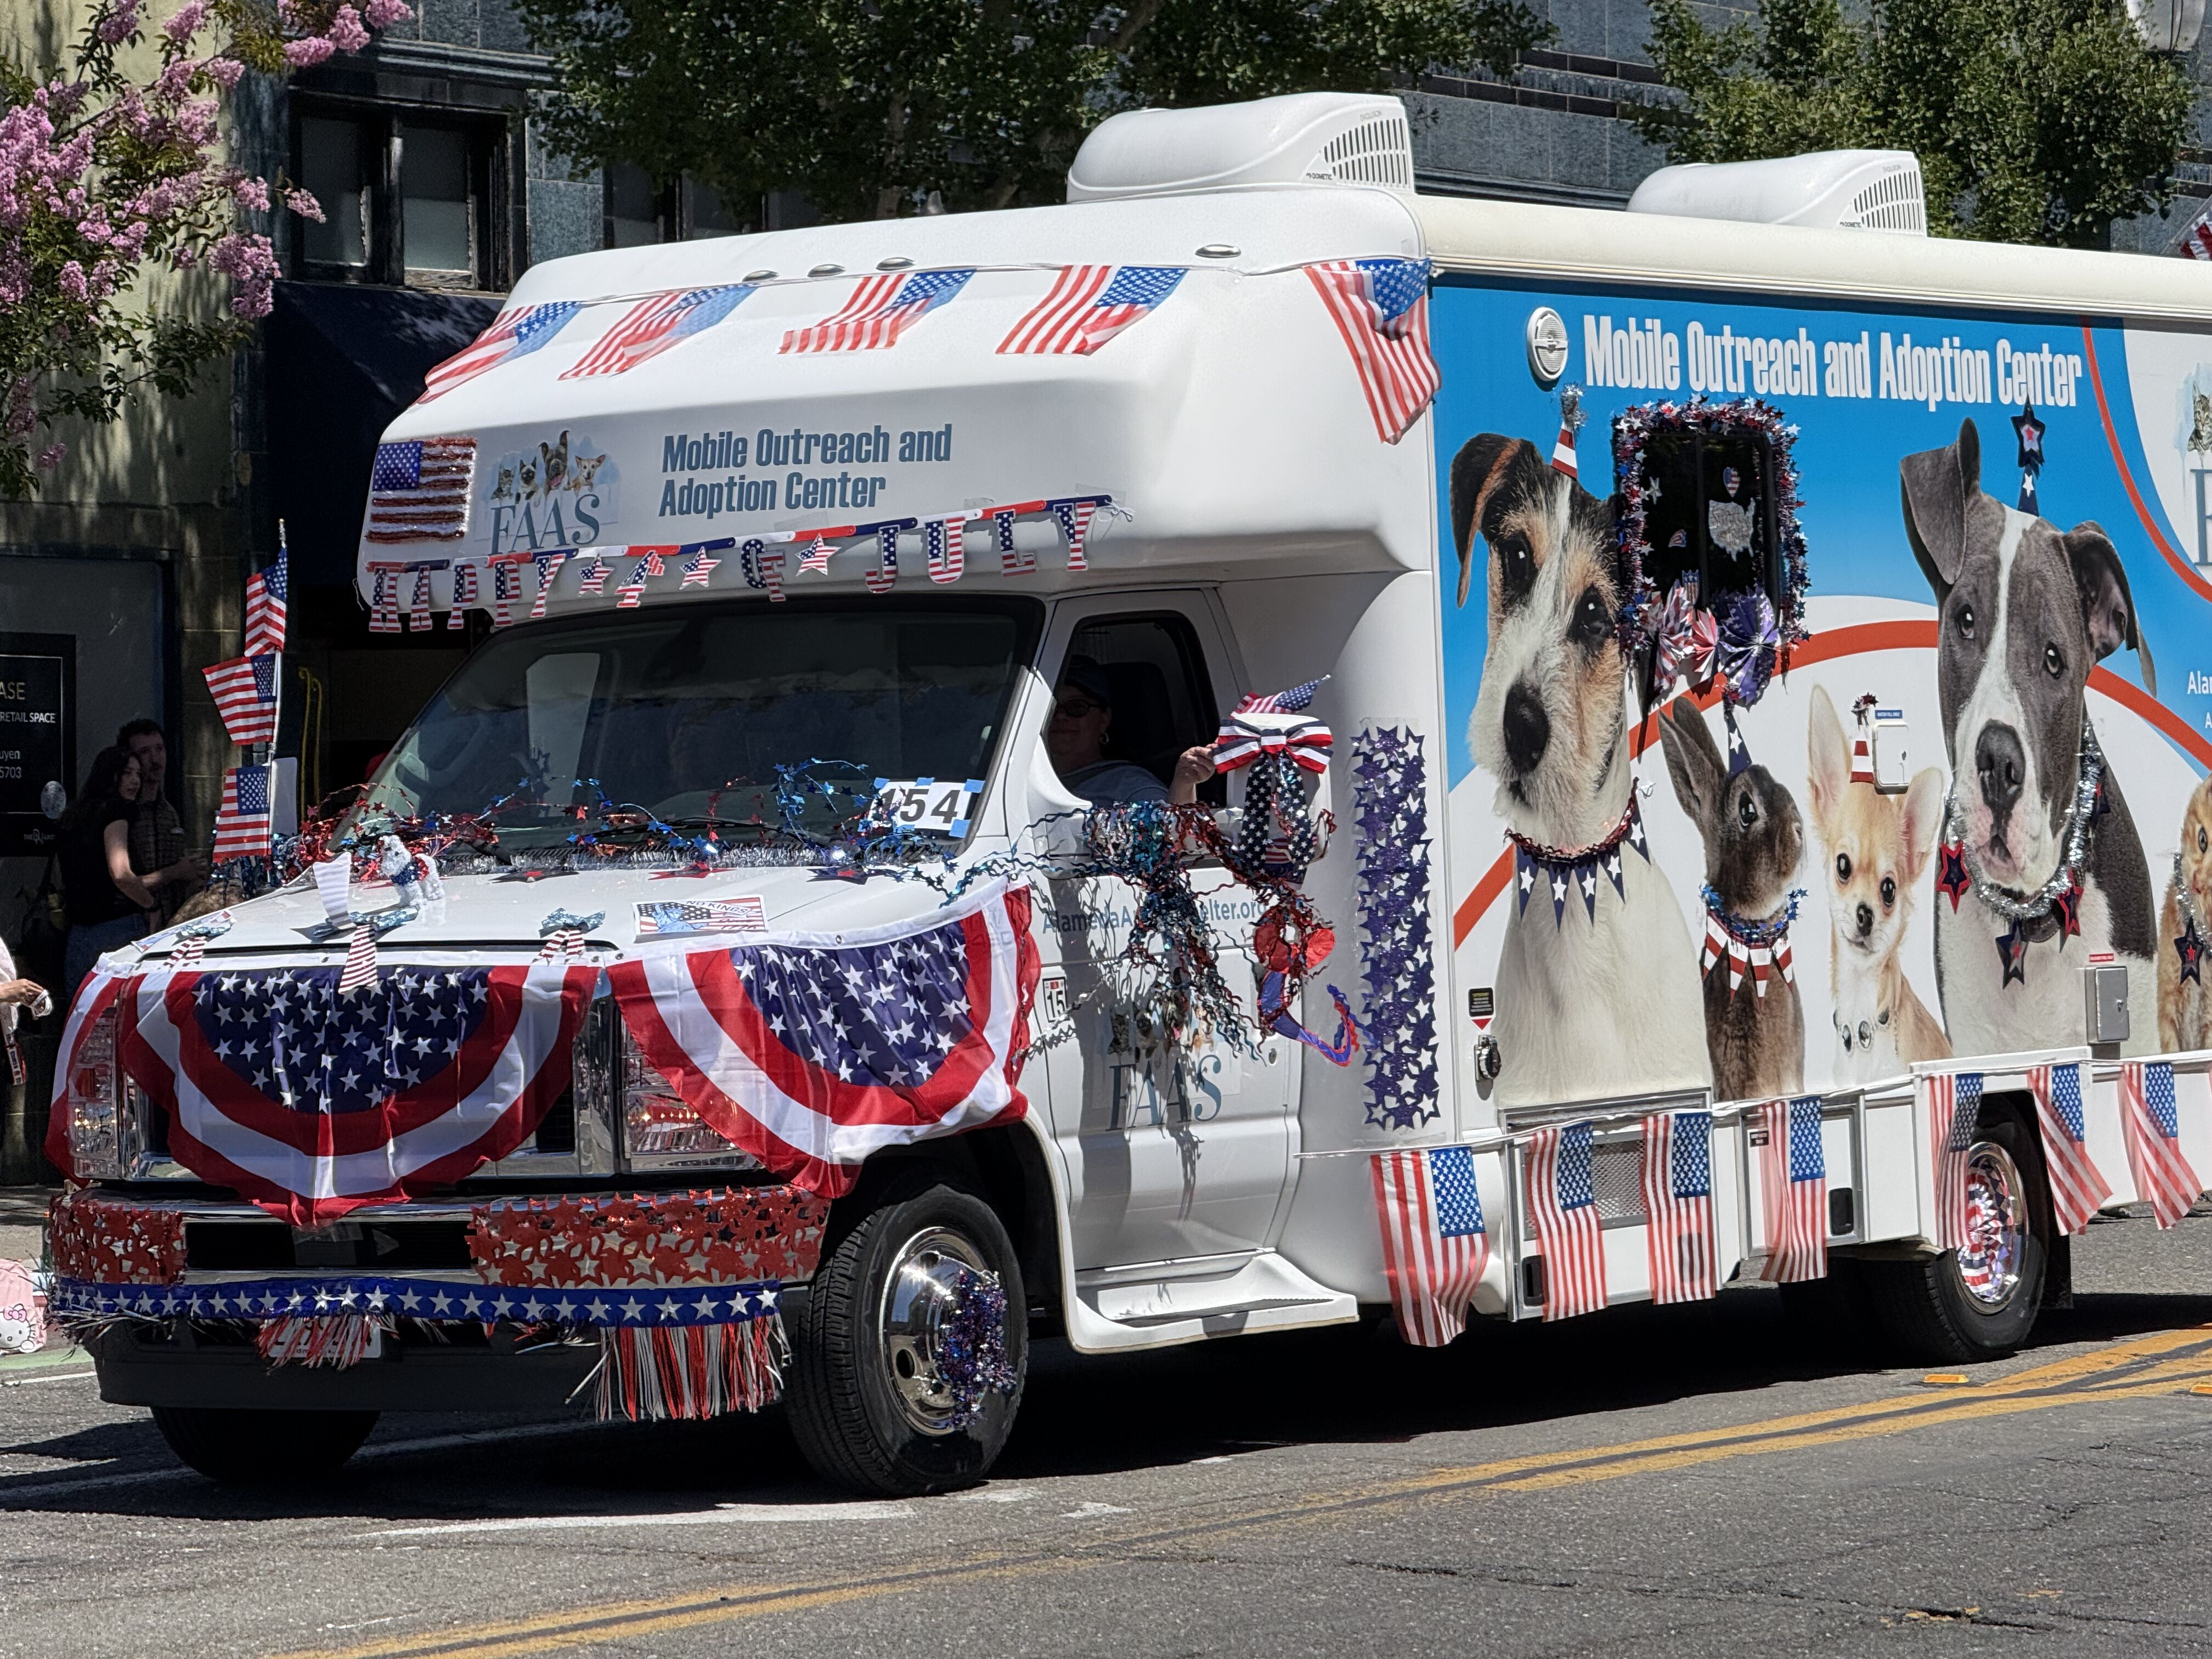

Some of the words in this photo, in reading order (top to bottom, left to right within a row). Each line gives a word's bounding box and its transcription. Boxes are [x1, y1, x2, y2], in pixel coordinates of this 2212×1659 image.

[1584, 314, 1680, 391] Mobile
[1687, 321, 1818, 396] Outreach
[1824, 330, 1871, 399] and
[1880, 331, 1991, 412] Adoption
[1996, 338, 2082, 408] Center
[662, 431, 748, 473] Mobile
[755, 425, 894, 467] Outreach
[898, 423, 952, 462] and
[659, 472, 777, 520] Adoption
[784, 471, 886, 510] Center
[490, 494, 600, 555] FAAS
[369, 553, 566, 633] HAPPY
[865, 501, 1097, 594] JULY
[0, 712, 28, 723] RETAIL
[29, 712, 56, 724] SPACE
[881, 788, 961, 824] 154
[708, 902, 748, 913] KINGS
[1047, 990, 1065, 1018] 15
[1105, 1054, 1222, 1132] FAAS
